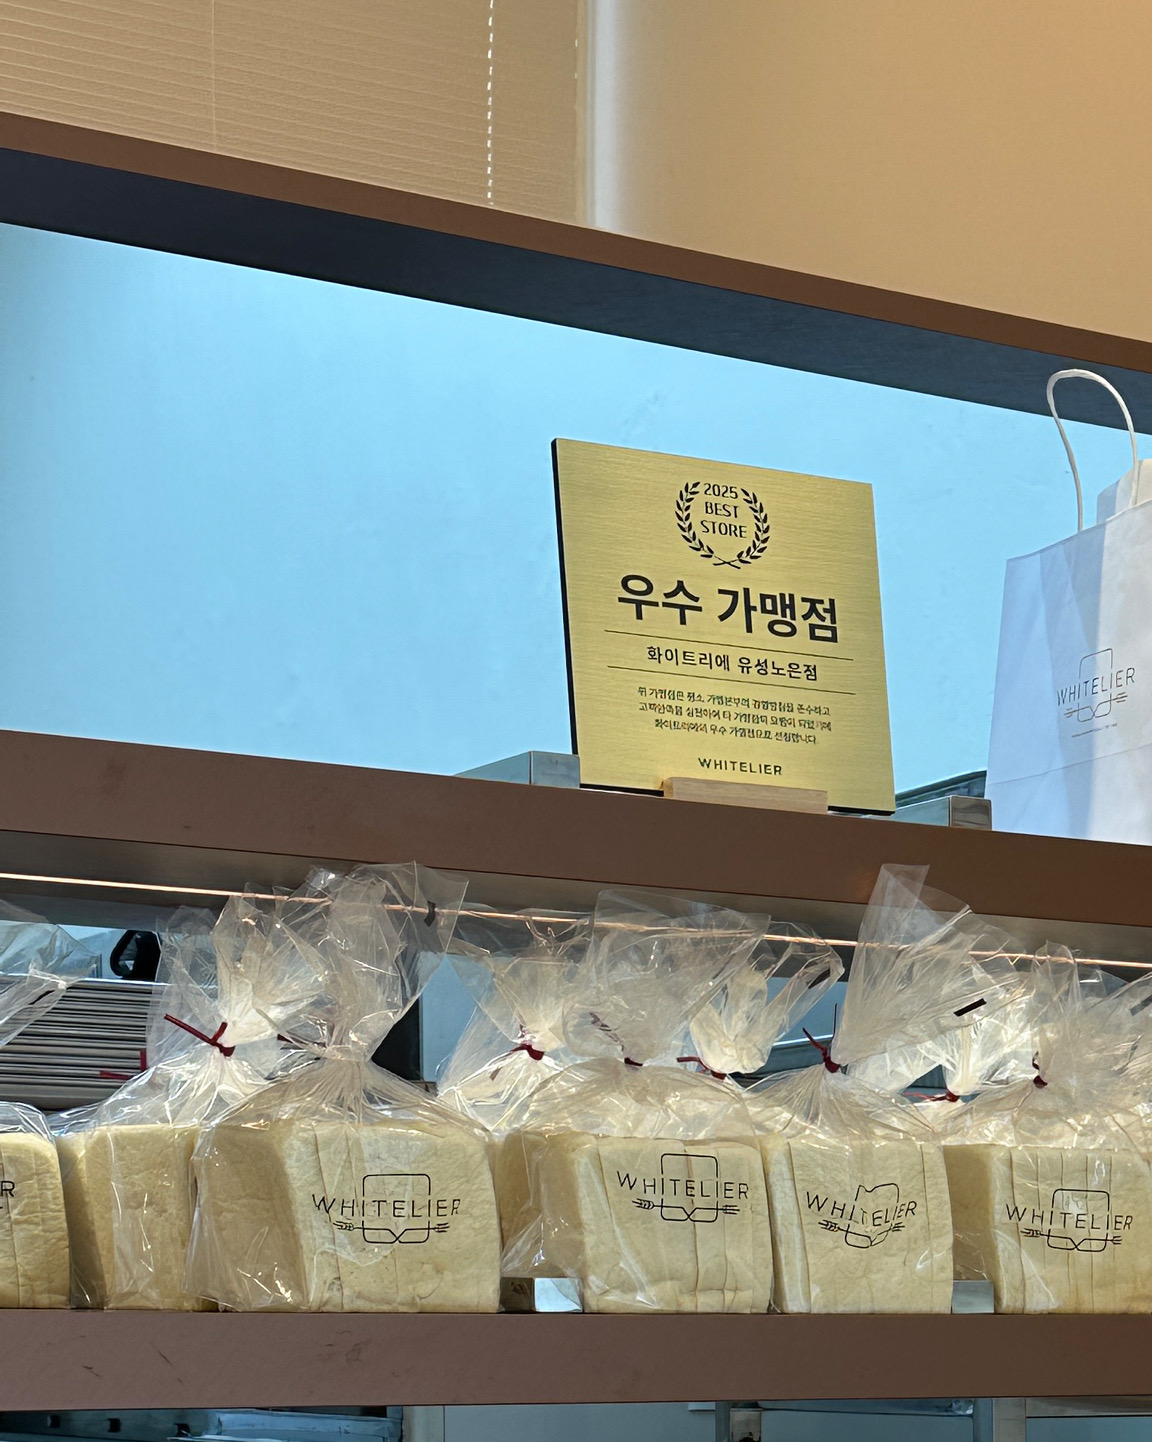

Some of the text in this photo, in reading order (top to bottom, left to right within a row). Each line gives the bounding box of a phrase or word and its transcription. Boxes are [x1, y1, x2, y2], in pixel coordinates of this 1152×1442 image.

[703, 482, 739, 500] 2025
[704, 501, 739, 519] BEST
[700, 519, 748, 539] STORE
[617, 574, 839, 643] 우수 가맹점
[647, 645, 818, 681] 화이트리에 유성노은점
[1056, 667, 1136, 706] WHITELIER
[698, 757, 783, 776] WHITELIER
[616, 1170, 749, 1200] WHITELIER
[312, 1193, 461, 1218] WHITELIER
[806, 1191, 918, 1227] WHITELIER
[1005, 1203, 1134, 1232] WHITELIER
